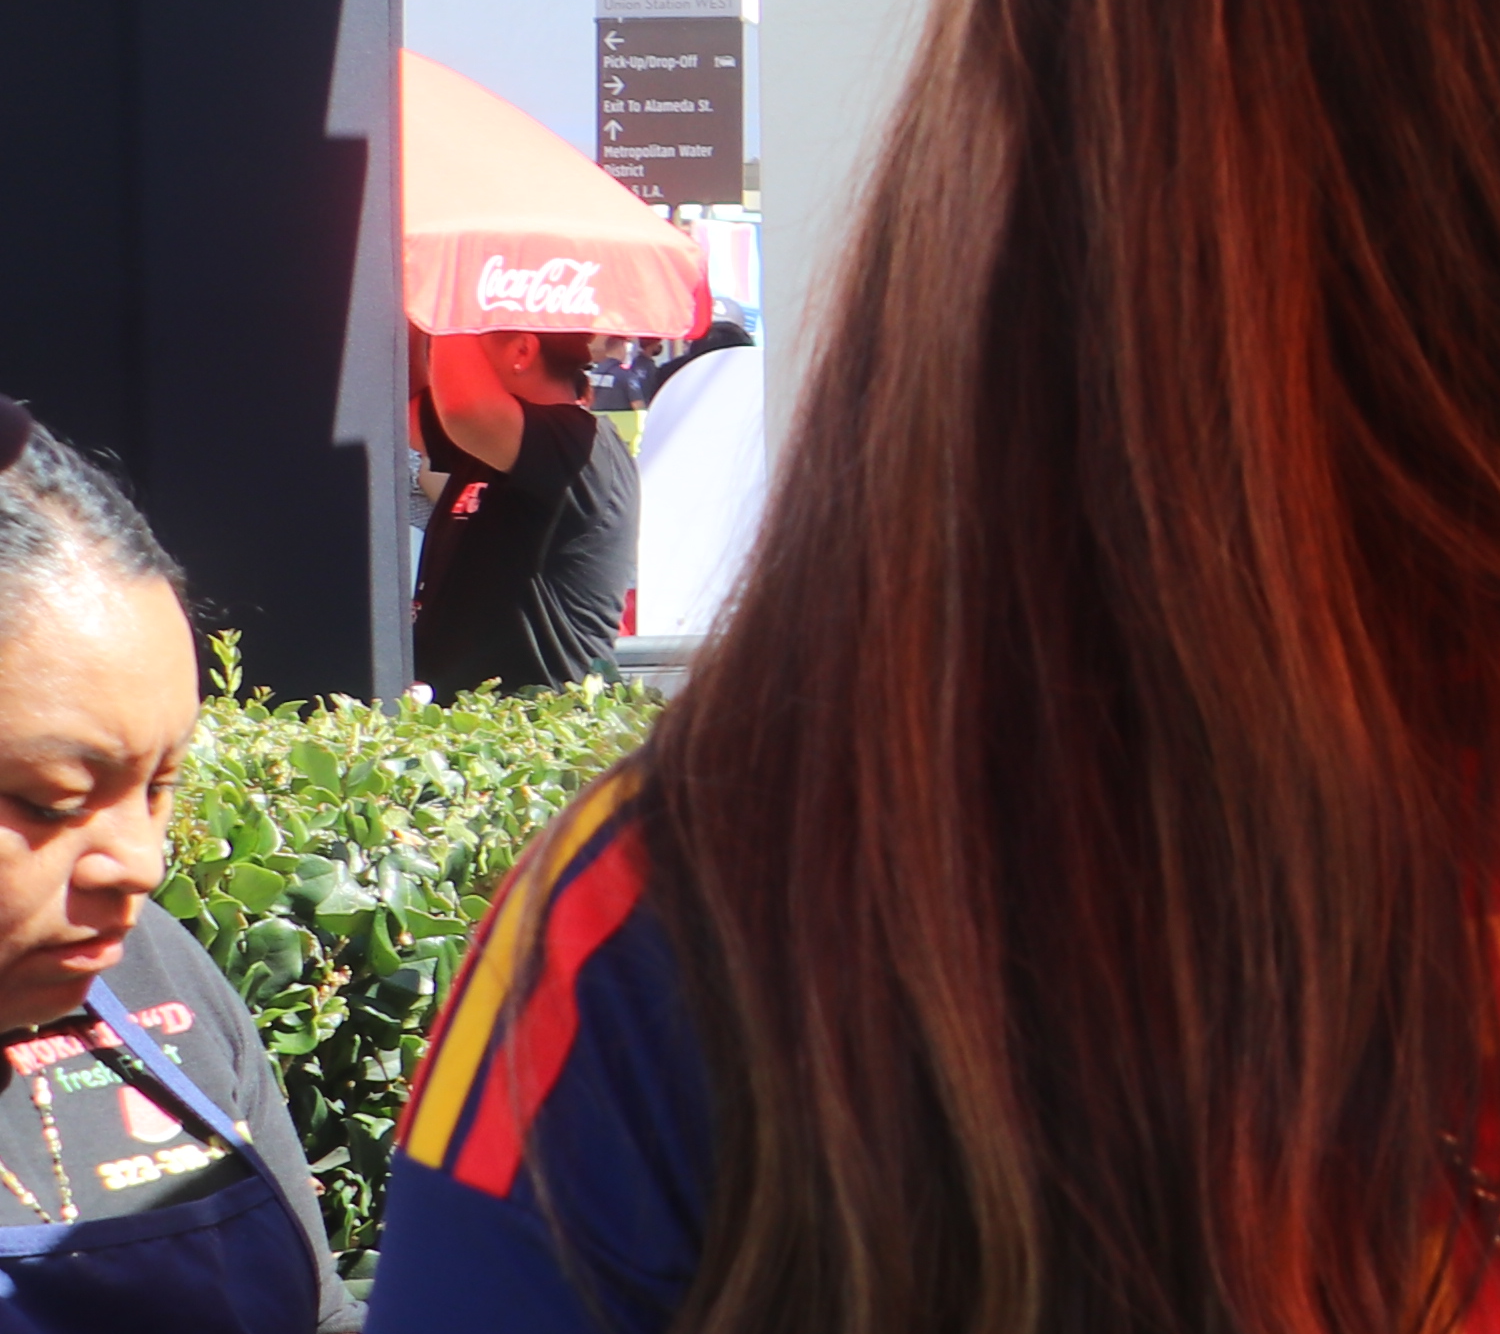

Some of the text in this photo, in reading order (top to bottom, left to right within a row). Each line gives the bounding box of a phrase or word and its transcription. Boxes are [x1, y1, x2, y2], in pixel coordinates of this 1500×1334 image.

[603, 54, 698, 71] Pick-Up/Drop-Off
[603, 99, 714, 113] Exit To Alameda St.
[603, 144, 713, 161] Metropolitan Water
[477, 255, 601, 315] Coca-Cola
